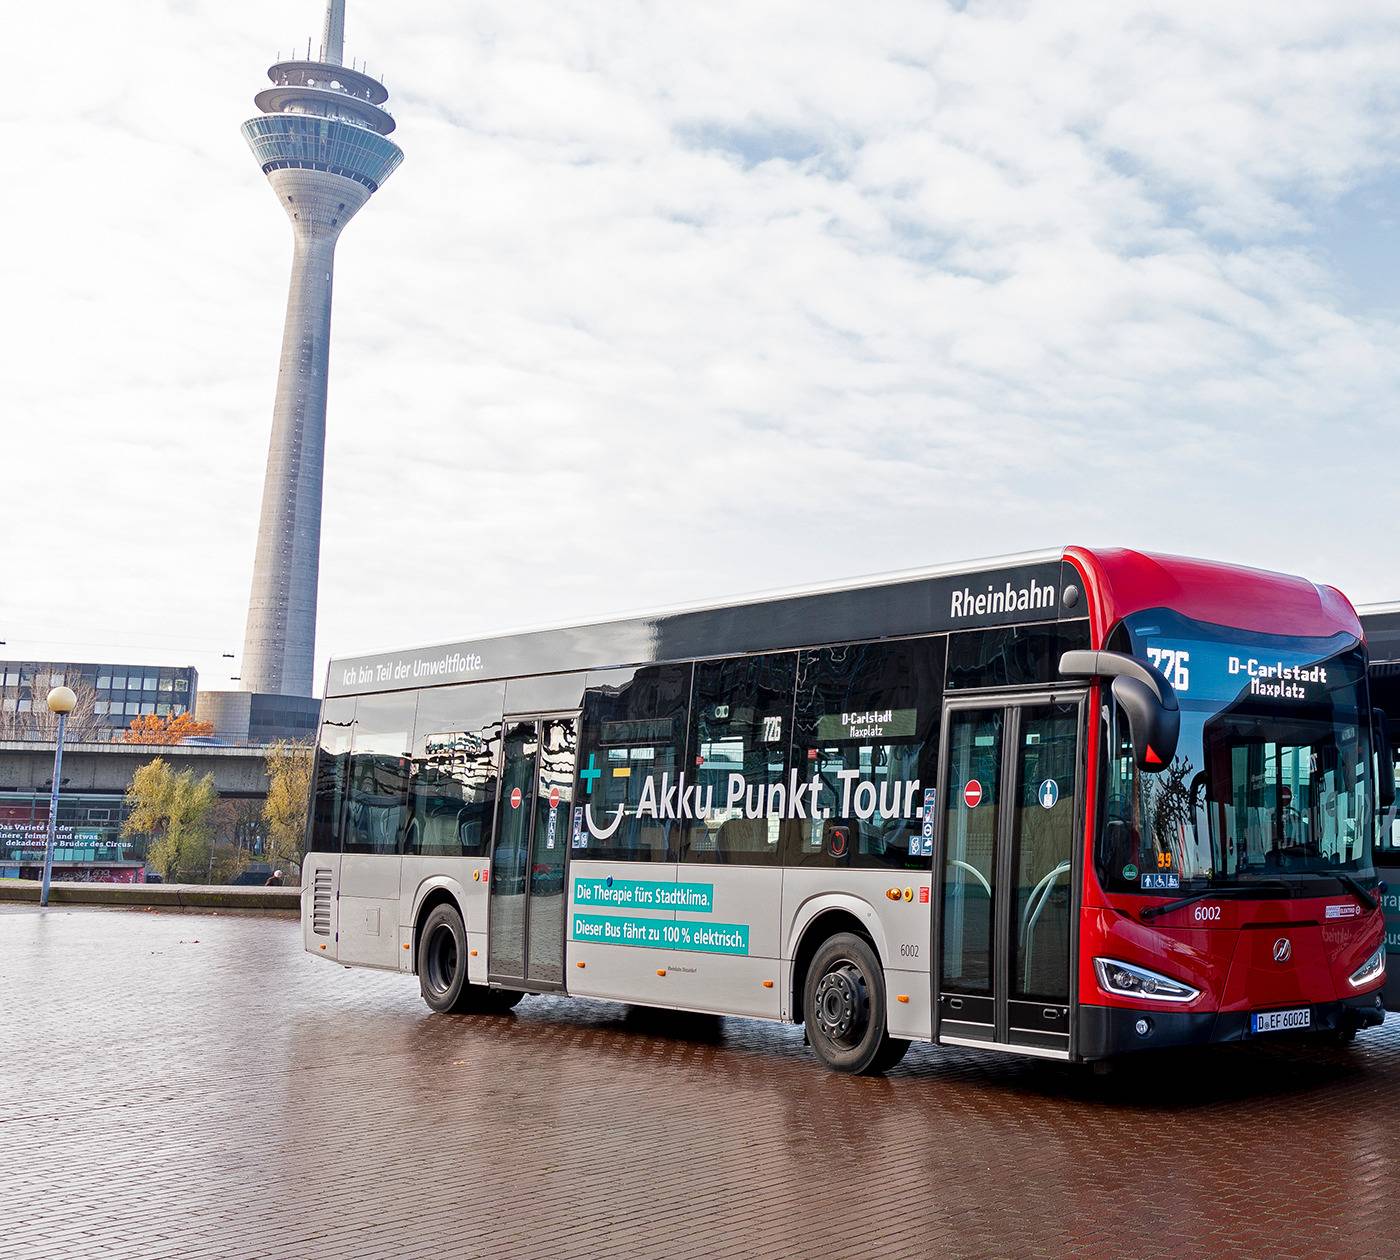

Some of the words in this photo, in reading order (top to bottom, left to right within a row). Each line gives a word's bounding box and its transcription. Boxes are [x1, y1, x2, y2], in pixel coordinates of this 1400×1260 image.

[950, 579, 1055, 618] Rheinbahn
[343, 669, 356, 686] Ich
[358, 665, 373, 684] bin
[376, 662, 392, 682] Teil
[394, 660, 411, 679] der
[413, 653, 484, 676] Umweltflotte.
[1147, 647, 1190, 691] 726
[1228, 656, 1327, 683] D-Carlstadt
[1251, 678, 1305, 699] Maxplatz
[842, 710, 892, 725] D-Carlstadt
[764, 716, 782, 742] 726
[850, 724, 883, 738] Maxplatz
[6, 839, 58, 847] dekadentee
[60, 840, 88, 848] Bruder
[90, 840, 104, 848] des
[577, 884, 591, 899] Die
[593, 884, 632, 905] Therapie
[634, 886, 653, 903] fürs
[655, 888, 710, 907] Stadtklima.
[1194, 906, 1221, 921] 6002
[575, 919, 603, 937] Dieser
[605, 921, 621, 938] Bus
[623, 922, 646, 940] fährt
[648, 929, 660, 941] zu
[663, 926, 680, 943] 100
[681, 928, 691, 944] %
[693, 928, 745, 948] elektrisch.
[900, 944, 920, 958] 6002
[1258, 1016, 1264, 1030] D
[1270, 1014, 1281, 1029] EF
[1283, 1011, 1309, 1027] 6002E
